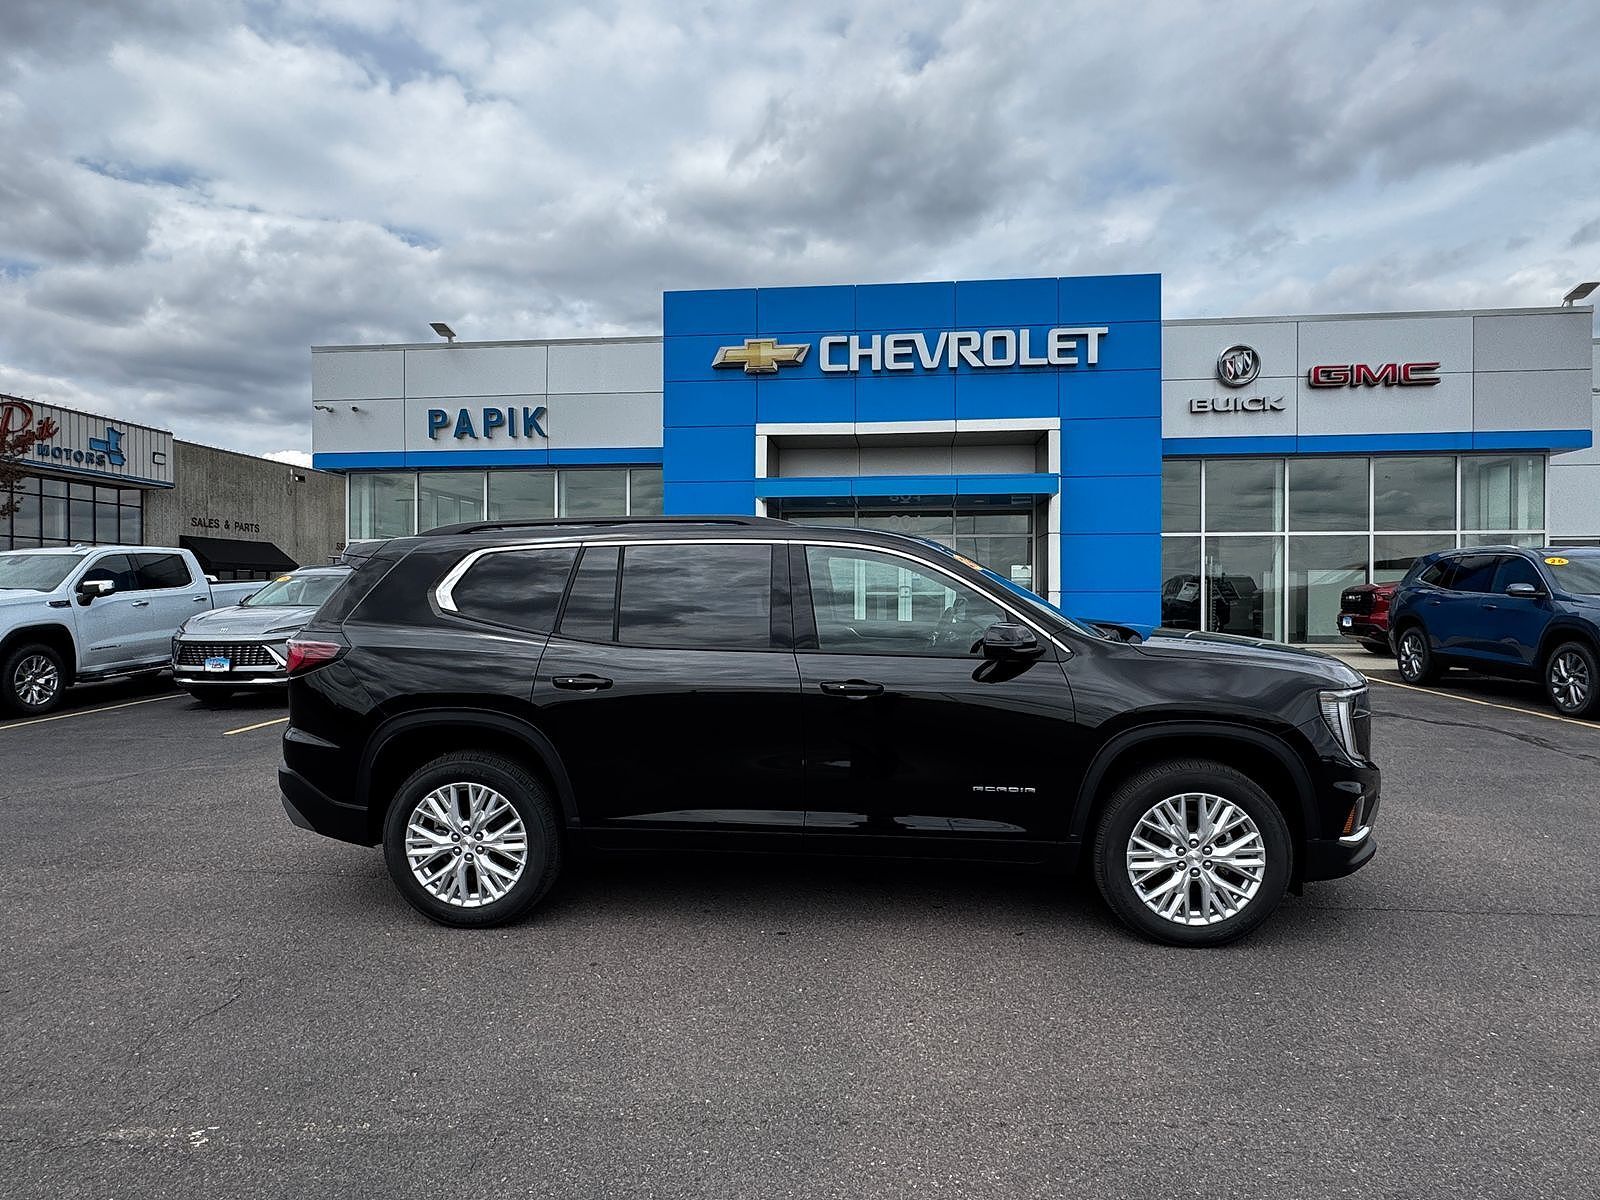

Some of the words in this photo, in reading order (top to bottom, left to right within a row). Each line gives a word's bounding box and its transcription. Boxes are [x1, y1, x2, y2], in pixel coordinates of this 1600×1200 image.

[819, 326, 1109, 373] CHEVROLET
[1309, 361, 1441, 388] GMC
[1189, 396, 1287, 413] BUICK
[427, 406, 548, 440] PAPIK
[36, 443, 106, 466] MOTORS
[191, 517, 220, 529] SALES
[224, 519, 230, 530] &
[234, 521, 260, 533] PARTS
